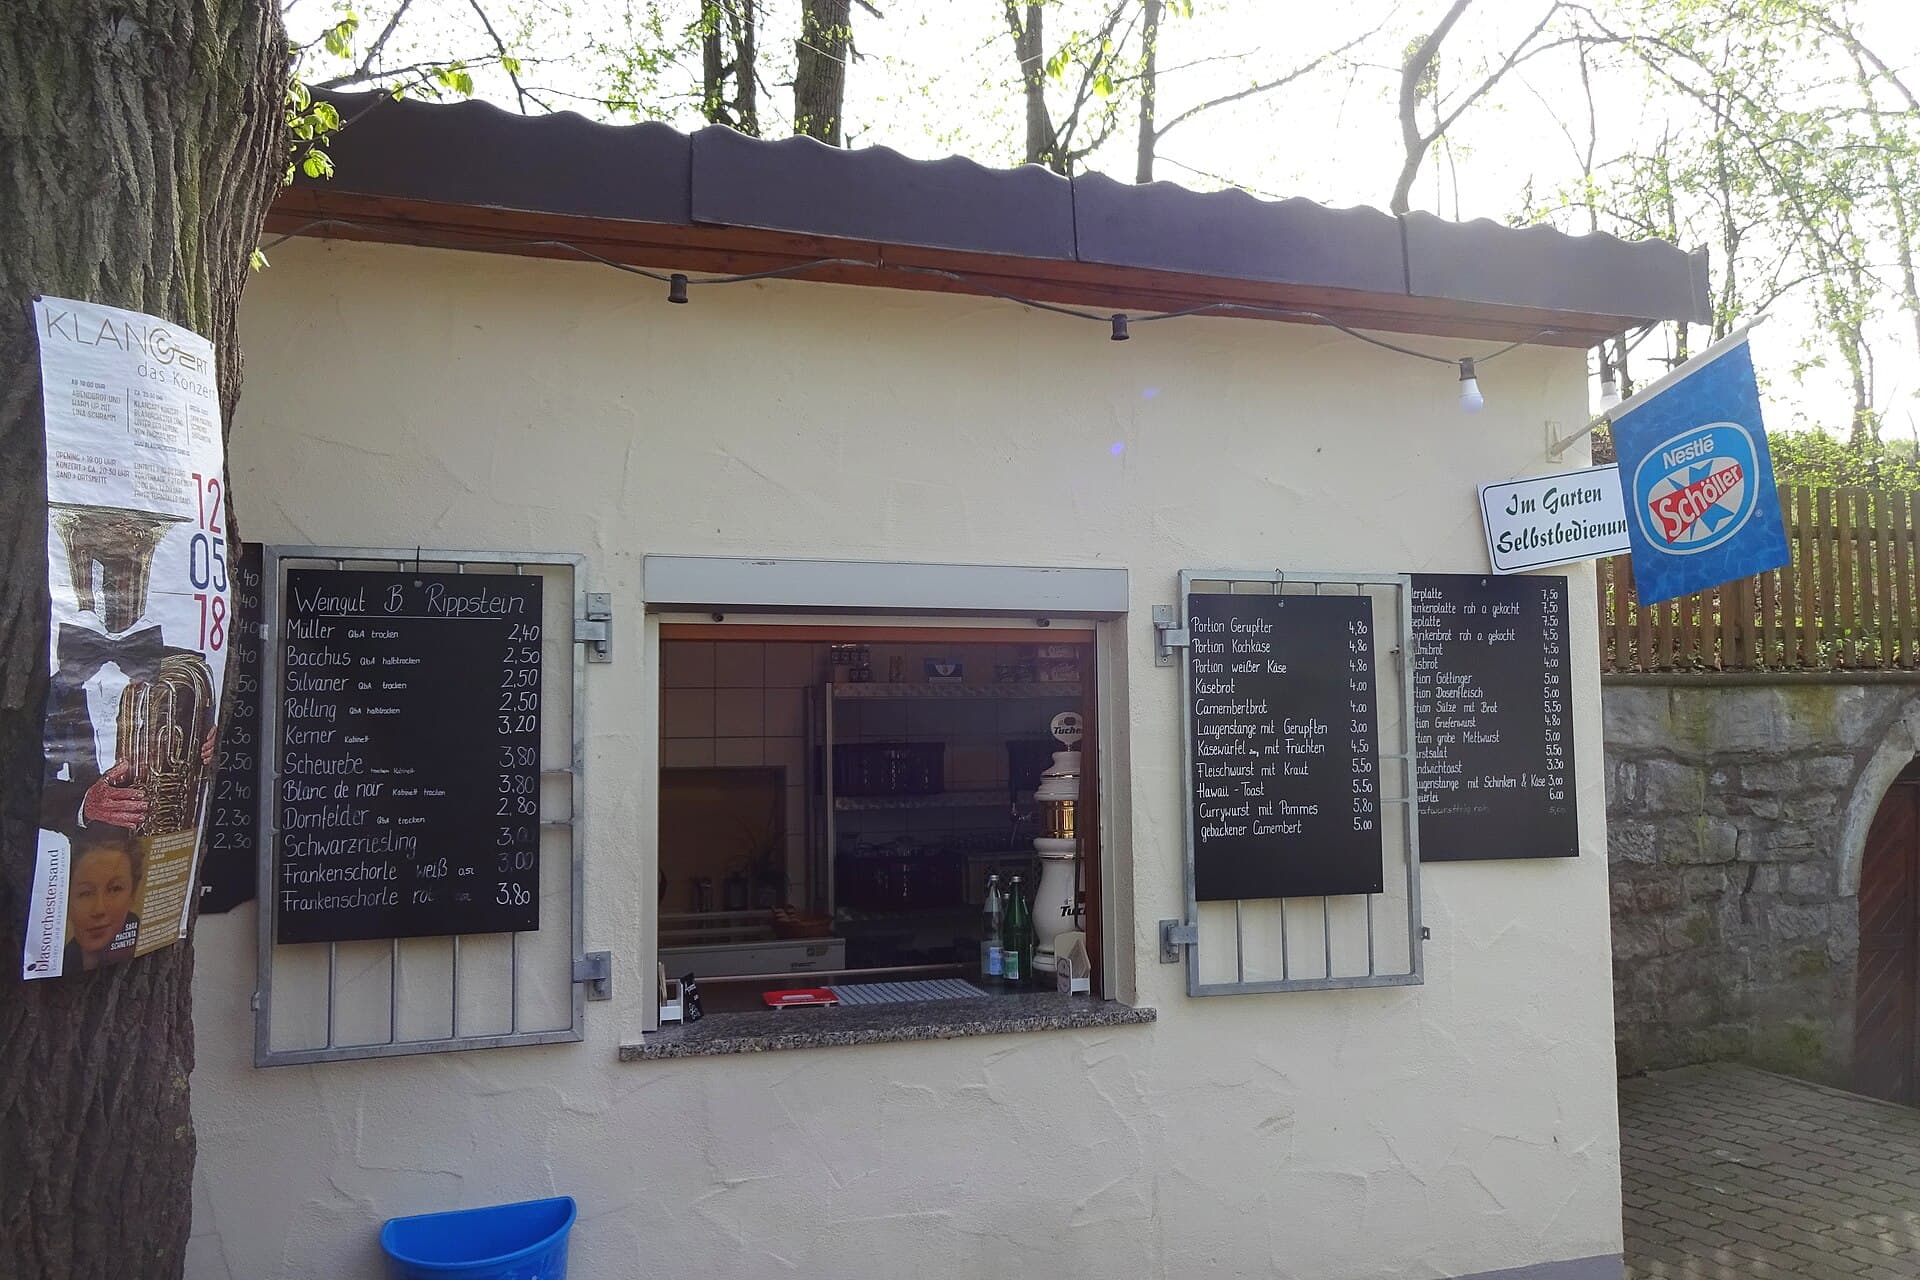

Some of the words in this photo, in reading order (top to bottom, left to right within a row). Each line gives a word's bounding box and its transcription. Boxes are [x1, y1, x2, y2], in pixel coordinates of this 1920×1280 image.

[137, 362, 165, 382] das
[192, 473, 221, 533] 12
[1505, 493, 1535, 516] Im
[1543, 486, 1602, 514] Garten
[1659, 464, 1742, 536] Schöller
[190, 533, 227, 593] 05
[294, 587, 365, 615] Weingut
[425, 583, 524, 616] Rippstein
[1541, 589, 1558, 601] 7,50
[1464, 602, 1476, 614] roh
[1492, 602, 1520, 618] gekocht
[1541, 601, 1558, 614] 7,50
[348, 630, 365, 639] QbA
[371, 630, 399, 638] trocken
[508, 624, 540, 642] 2,40
[1191, 617, 1225, 633] Portion
[1230, 617, 1273, 637] Gerupfter
[1349, 621, 1367, 635] 4,80
[1460, 629, 1472, 640] roh
[1488, 629, 1515, 645] gekocht
[288, 646, 351, 666] Bacchus
[360, 657, 376, 666] QbA
[382, 657, 420, 665] halbtrocken
[503, 647, 540, 664] 2,50
[1192, 638, 1224, 653] Portion
[1349, 639, 1367, 653] 4,80
[1193, 659, 1223, 674] Portion
[1232, 661, 1260, 673] weißer
[1267, 660, 1287, 674] Käse
[1349, 659, 1367, 672] 4,80
[287, 671, 350, 691] Silvaner
[358, 682, 372, 690] QbA
[382, 682, 407, 690] trocken
[502, 669, 538, 688] 2,50
[1195, 678, 1235, 694] Käsebrot
[1350, 678, 1367, 691] 4,00
[1436, 685, 1483, 699] Dosenfleisch
[284, 698, 337, 722] Rotling
[499, 692, 538, 712] 2,50
[1195, 699, 1268, 715] Camembertbrot
[1436, 701, 1456, 713] Sülze
[1463, 702, 1475, 713] mit
[1480, 701, 1498, 713] Brot
[1544, 701, 1561, 713] 5,50
[285, 725, 336, 744] Kerner
[498, 715, 536, 734] 3,20
[1197, 719, 1256, 740] Laugenstange
[1260, 720, 1275, 734] mit
[1283, 718, 1328, 738] Gerupften
[1350, 720, 1367, 733] 3,00
[1437, 730, 1456, 746] grobe
[1463, 730, 1500, 744] Mettwurst
[1197, 739, 1246, 757] Käsewürfel
[1264, 739, 1280, 754] mit
[1285, 738, 1325, 754] Früchten
[1351, 739, 1369, 753] 4,50
[284, 752, 364, 776] Scheurebe
[499, 746, 536, 769] 3,80
[1196, 761, 1255, 778] Fleischwurst
[1261, 763, 1275, 776] mit
[1284, 761, 1309, 775] Kraut
[1352, 758, 1371, 773] 5,50
[283, 780, 327, 802] Blanc
[334, 781, 349, 798] de
[356, 783, 384, 798] noir
[498, 774, 535, 794] 3,80
[1240, 781, 1265, 796] Toast
[1352, 779, 1373, 793] 5,50
[1467, 776, 1479, 788] mit
[1484, 776, 1516, 788] Schinken
[283, 804, 370, 830] Dornfelder
[398, 816, 425, 825] trocken
[496, 797, 536, 816] 2,80
[1199, 801, 1250, 822] Currywurst
[1258, 801, 1273, 816] mit
[1279, 800, 1318, 815] Pommes
[1353, 797, 1373, 813] 5,80
[1201, 825, 1247, 842] gebackener
[1253, 820, 1302, 836] Camembert
[284, 829, 417, 859] Schwarzriesling
[283, 861, 398, 885] Frankenschorle
[416, 857, 448, 879] weiß
[280, 887, 399, 912] Frankenschorle
[496, 882, 530, 905] 3,80
[35, 850, 58, 972] blasorchestersand
